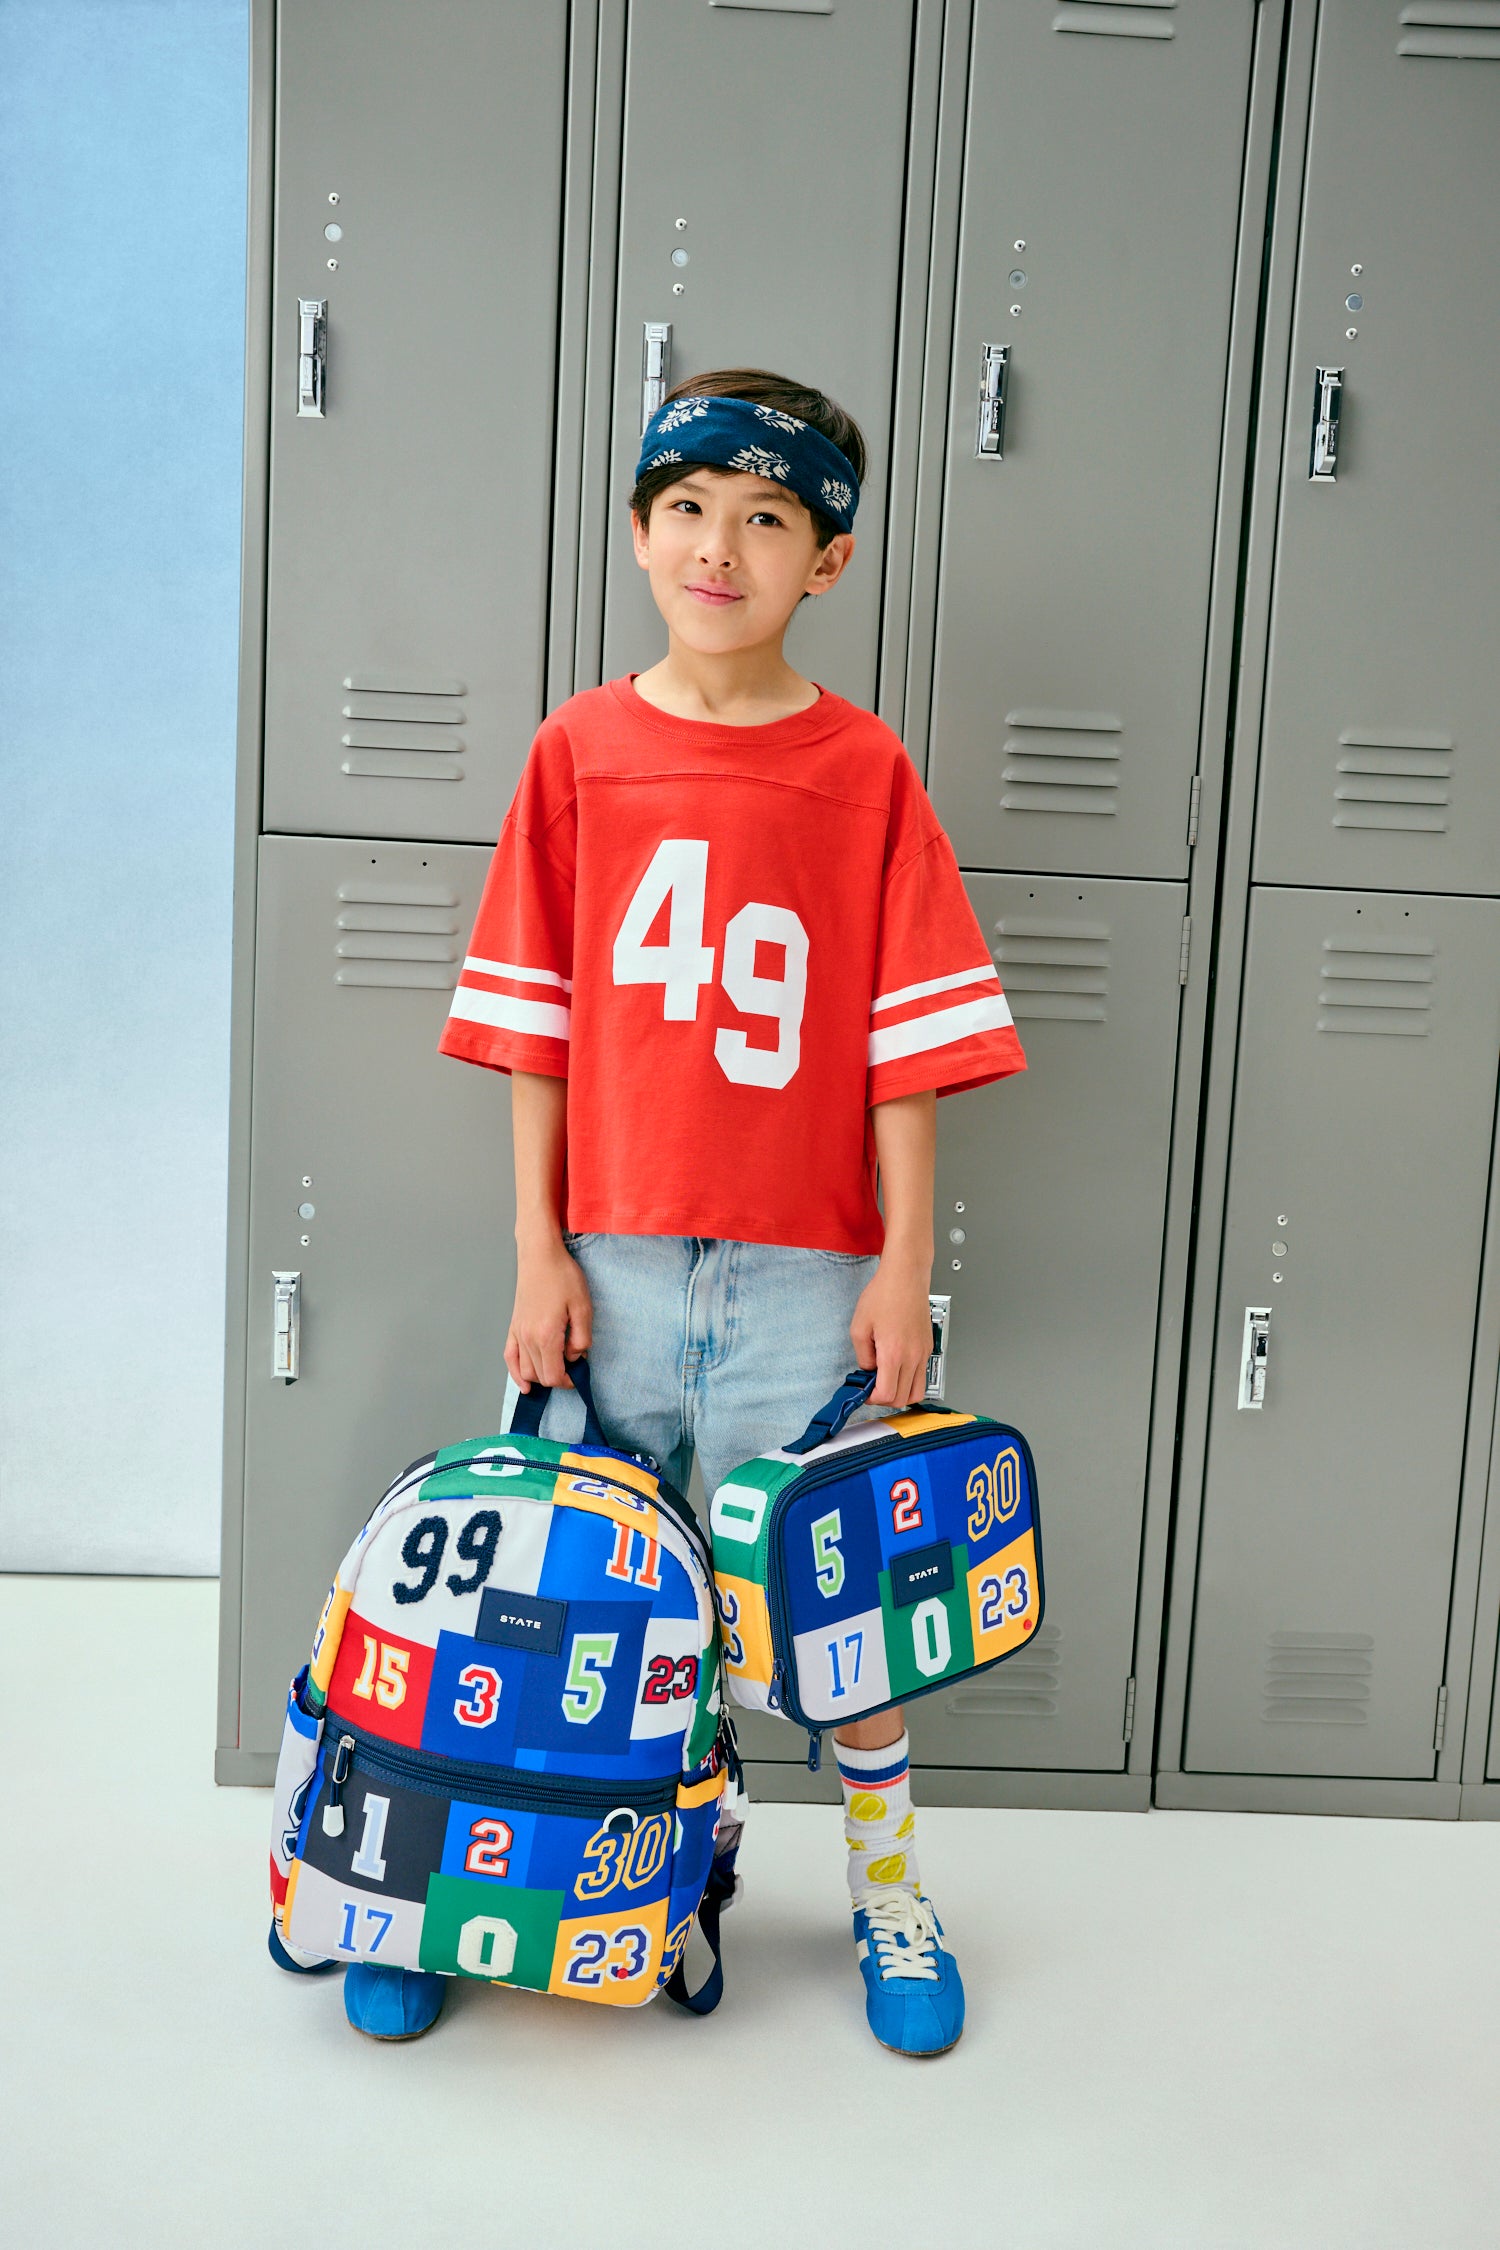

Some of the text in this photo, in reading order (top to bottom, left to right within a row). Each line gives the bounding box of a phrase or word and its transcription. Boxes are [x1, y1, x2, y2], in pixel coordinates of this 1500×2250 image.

[613, 839, 809, 1090] 49
[890, 1477, 923, 1534] 2
[966, 1446, 1020, 1542] 30
[392, 1509, 503, 1604] 99
[605, 1521, 662, 1592] 11
[811, 1508, 845, 1598] 5
[908, 1565, 939, 1583] STATE
[499, 1614, 542, 1630] STATE
[978, 1563, 1030, 1635] 23
[352, 1634, 411, 1711] 15
[826, 1628, 865, 1701] 17
[911, 1597, 952, 1677] 0
[454, 1663, 502, 1729] 3
[561, 1633, 619, 1725] 5
[641, 1655, 698, 1704] 23
[350, 1792, 391, 1882] 1
[464, 1817, 514, 1878] 2
[574, 1812, 672, 1901] 30
[336, 1899, 396, 1953] 17
[456, 1914, 518, 1977] 0
[562, 1924, 652, 1988] 23
